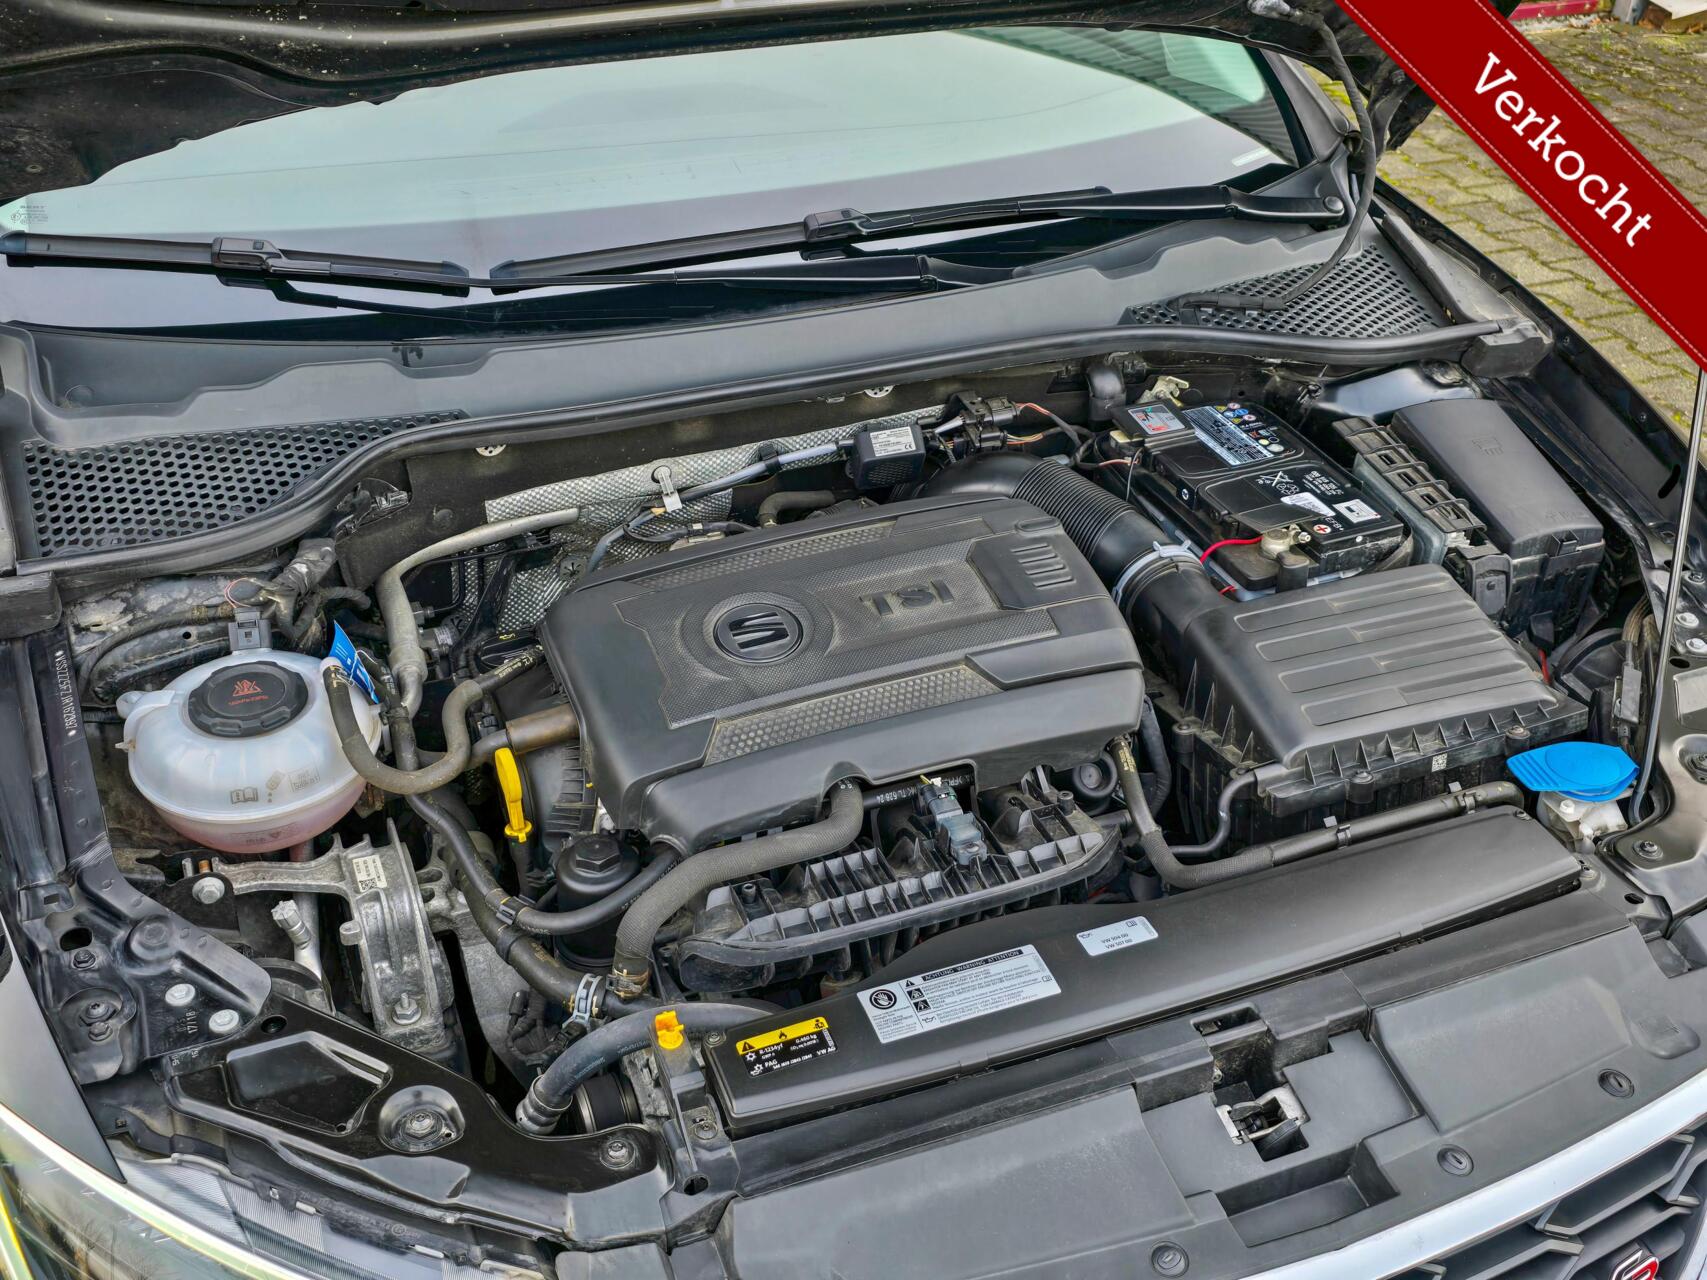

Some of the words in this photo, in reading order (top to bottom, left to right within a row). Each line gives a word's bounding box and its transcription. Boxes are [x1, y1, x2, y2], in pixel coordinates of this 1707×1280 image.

[859, 577, 955, 617] TSI
[925, 967, 955, 981] ACHTUNG
[957, 960, 986, 972] WARNING
[987, 951, 1020, 964] ATTENTION
[816, 1049, 827, 1057] VW
[765, 1059, 778, 1068] PAG
